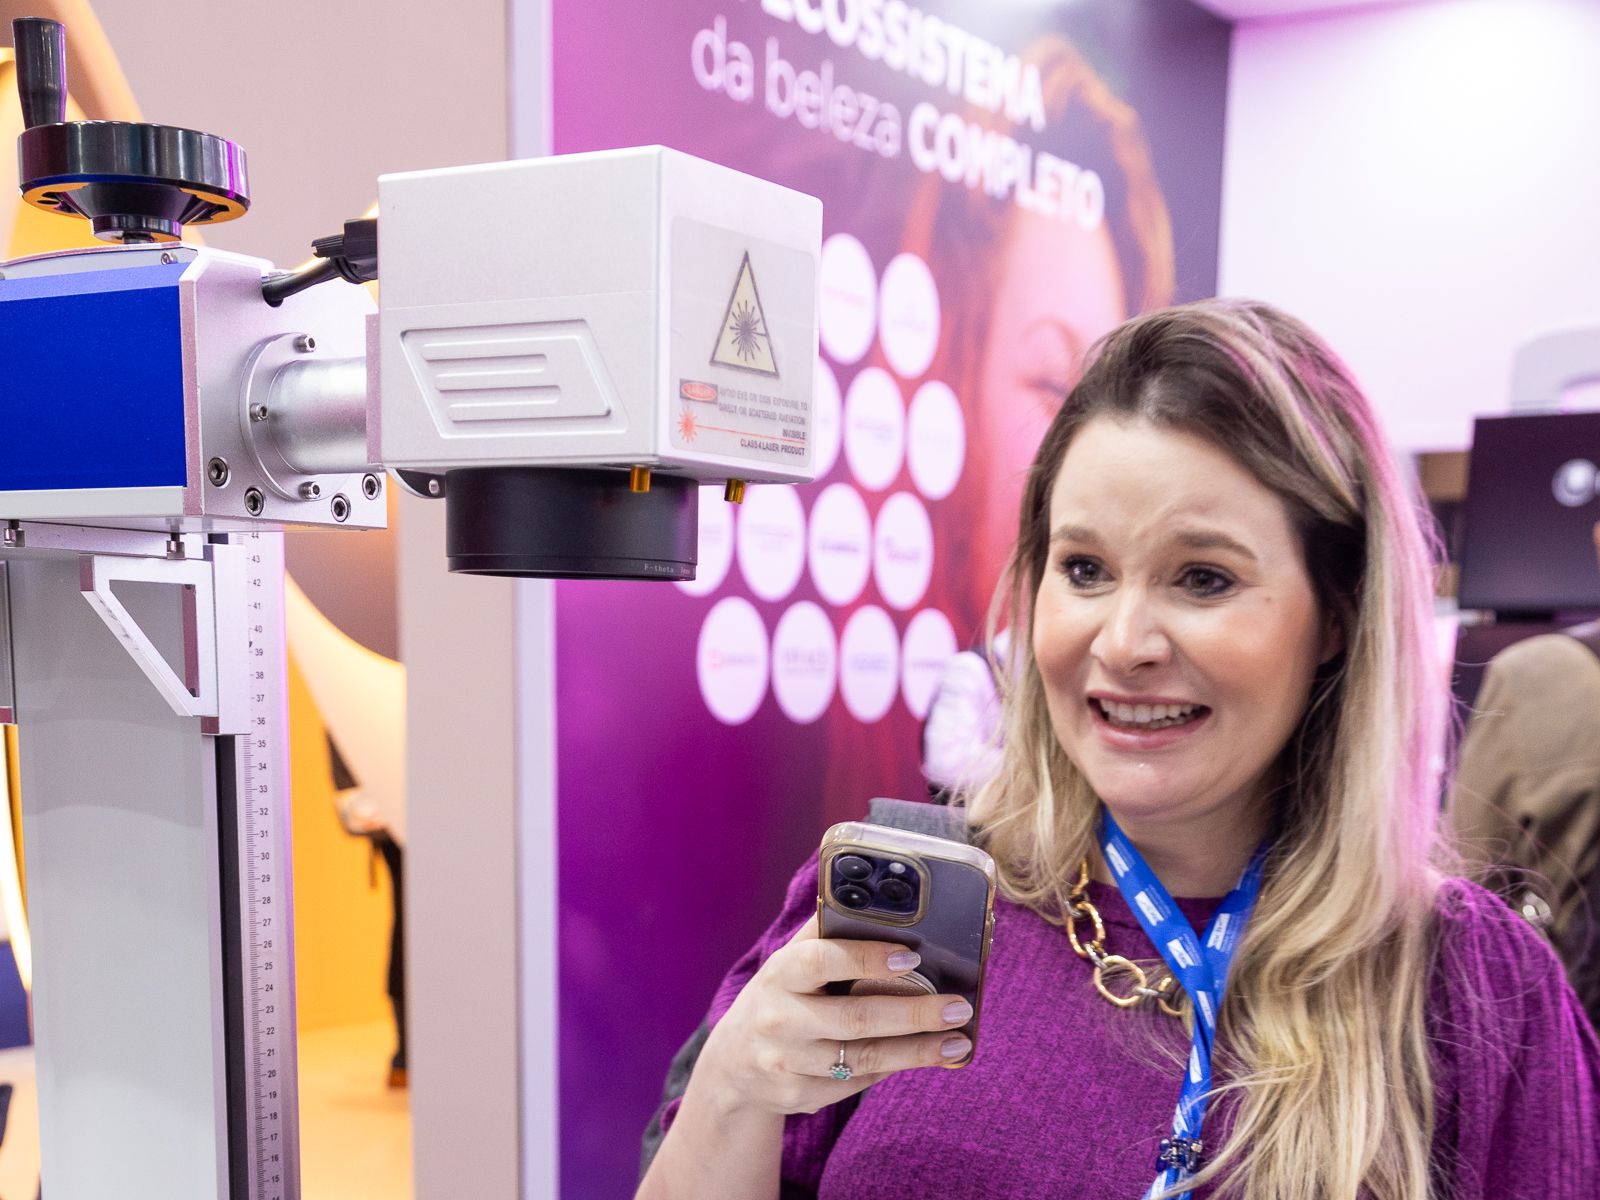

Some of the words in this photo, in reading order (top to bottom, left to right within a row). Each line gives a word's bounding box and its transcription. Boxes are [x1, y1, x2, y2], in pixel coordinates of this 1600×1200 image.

[761, 0, 1046, 133] COSSISTEMA
[691, 14, 755, 103] da
[765, 36, 901, 158] beleza
[907, 102, 1106, 232] COMPLETO
[740, 438, 758, 448] CLASS
[762, 441, 779, 452] LASER
[781, 444, 805, 456] PRODUCT
[252, 555, 260, 563] 43
[644, 563, 674, 573] F-theta
[253, 578, 261, 586] 42
[255, 648, 263, 656] 39
[256, 694, 264, 702] 37
[257, 717, 265, 725] 36
[258, 740, 266, 748] 35
[258, 762, 266, 770] 34
[259, 785, 268, 793] 33
[260, 808, 268, 816] 32
[260, 830, 268, 838] 31
[261, 852, 269, 860] 30
[262, 874, 270, 882] 29
[262, 896, 271, 904] 28
[263, 918, 271, 926] 27
[264, 940, 272, 948] 26
[265, 962, 272, 970] 25
[266, 984, 273, 992] 24
[266, 1005, 274, 1013] 23
[267, 1027, 274, 1035] 22
[268, 1070, 276, 1078] 20
[269, 1091, 277, 1099] 19
[270, 1112, 278, 1120] 18
[270, 1133, 278, 1141] 17
[271, 1154, 279, 1162] 16
[272, 1175, 280, 1183] 15
